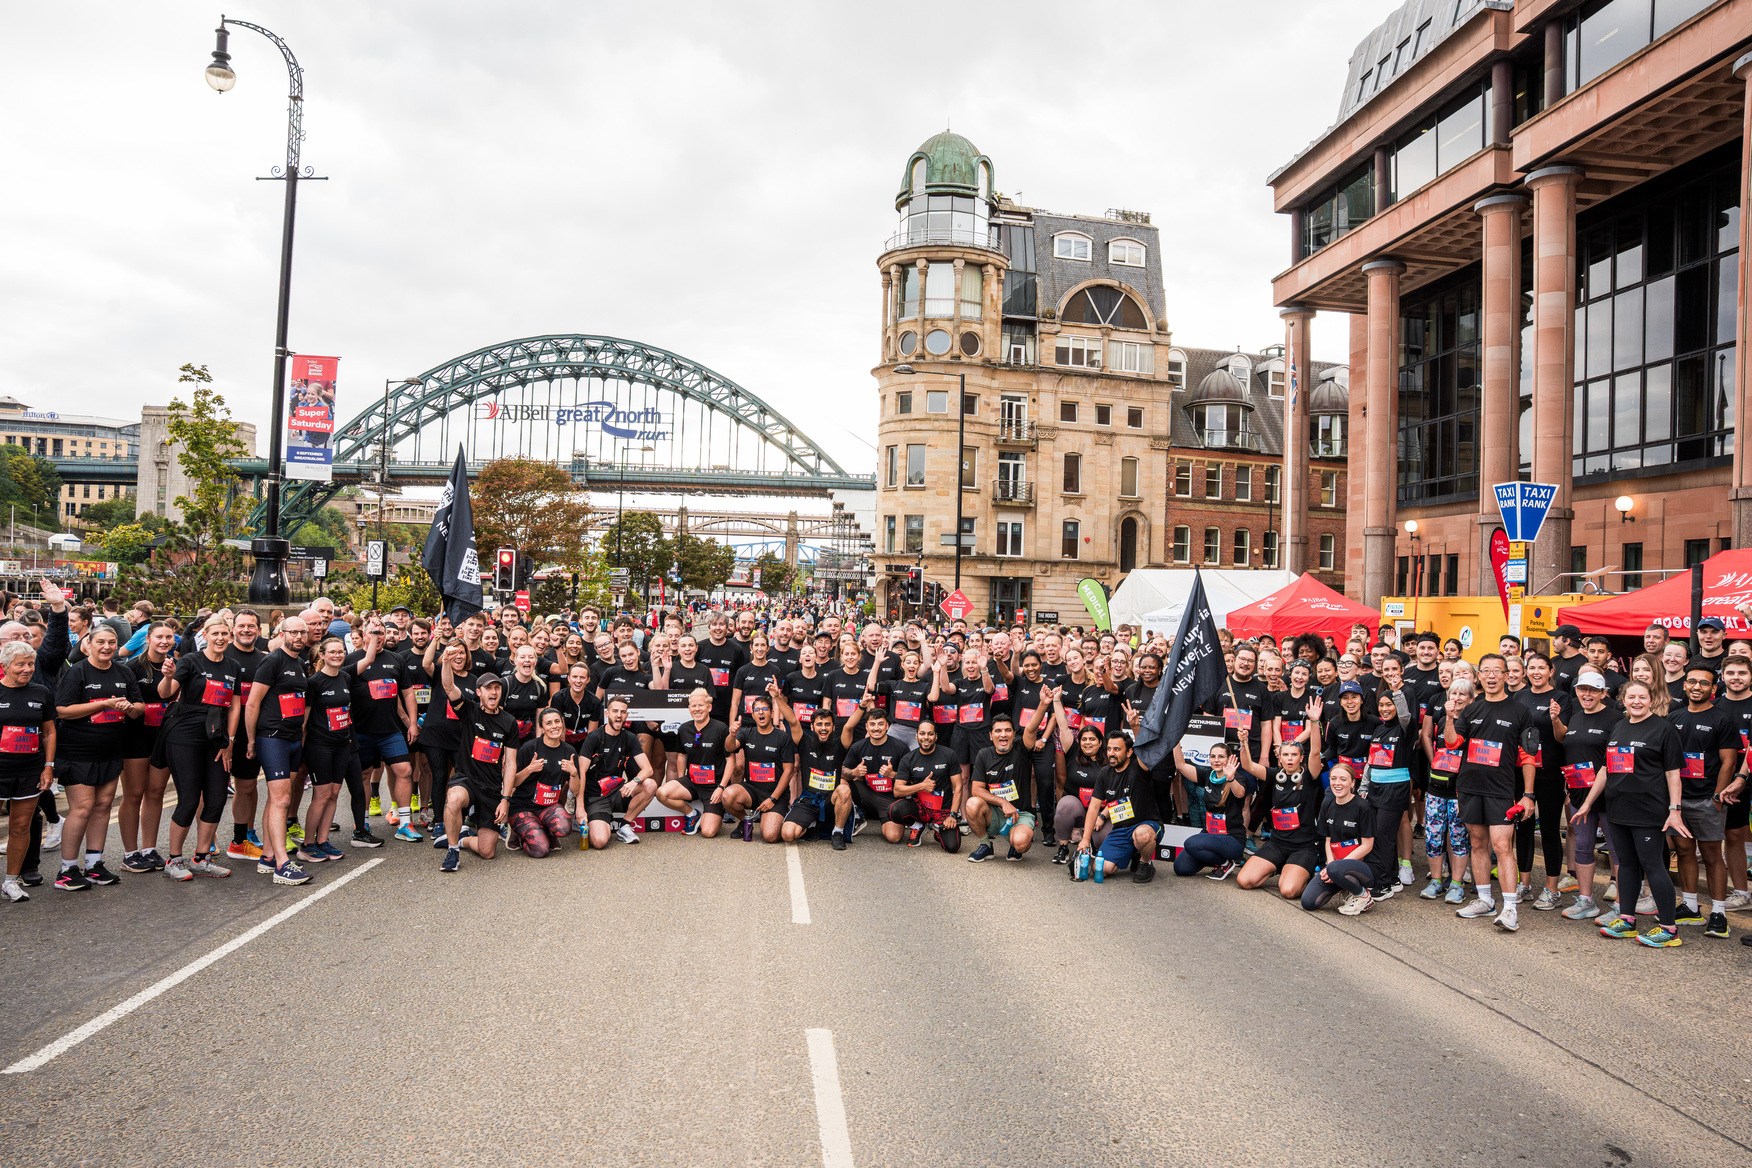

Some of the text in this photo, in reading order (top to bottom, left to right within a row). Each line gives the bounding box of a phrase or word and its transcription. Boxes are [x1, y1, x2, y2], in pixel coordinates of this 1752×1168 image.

[22, 411, 46, 419] Hilton
[299, 409, 326, 418] Super
[556, 406, 601, 426] great
[615, 407, 662, 424] north
[290, 419, 332, 430] Saturday
[636, 430, 667, 441] run
[1497, 486, 1515, 499] TAXI
[1524, 487, 1551, 499] TAXI
[1499, 499, 1517, 508] RANK
[1521, 500, 1547, 510] RANK
[1081, 584, 1106, 621] MEDICAL
[1529, 619, 1545, 627] Parking
[14, 735, 33, 743] JANET
[14, 744, 30, 752] 1273
[1475, 747, 1490, 755] FRANK
